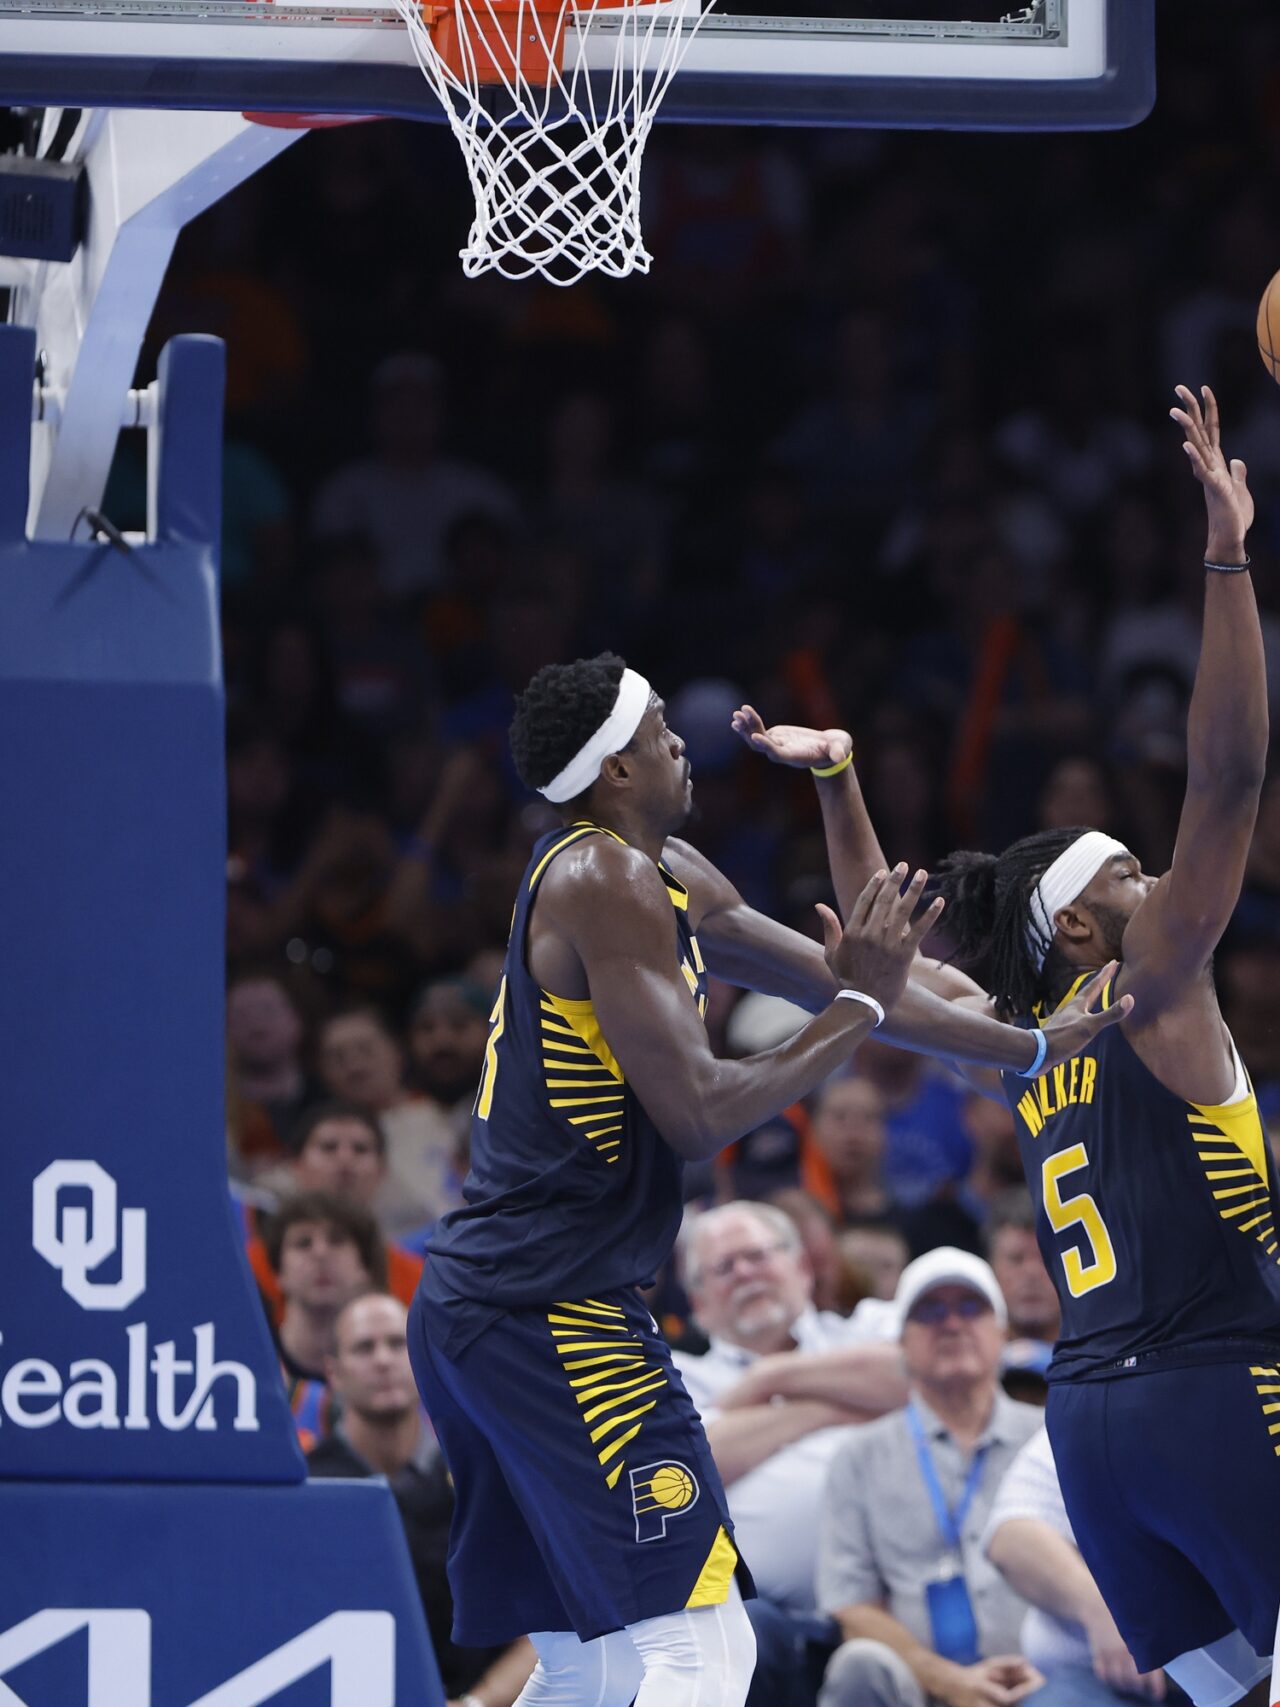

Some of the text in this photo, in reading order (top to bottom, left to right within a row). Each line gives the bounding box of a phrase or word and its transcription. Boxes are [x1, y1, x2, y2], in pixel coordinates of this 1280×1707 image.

[1017, 1056, 1097, 1138] WLKER
[32, 1159, 147, 1310] OU
[1042, 1142, 1117, 1298] 5
[0, 1321, 260, 1431] ealth
